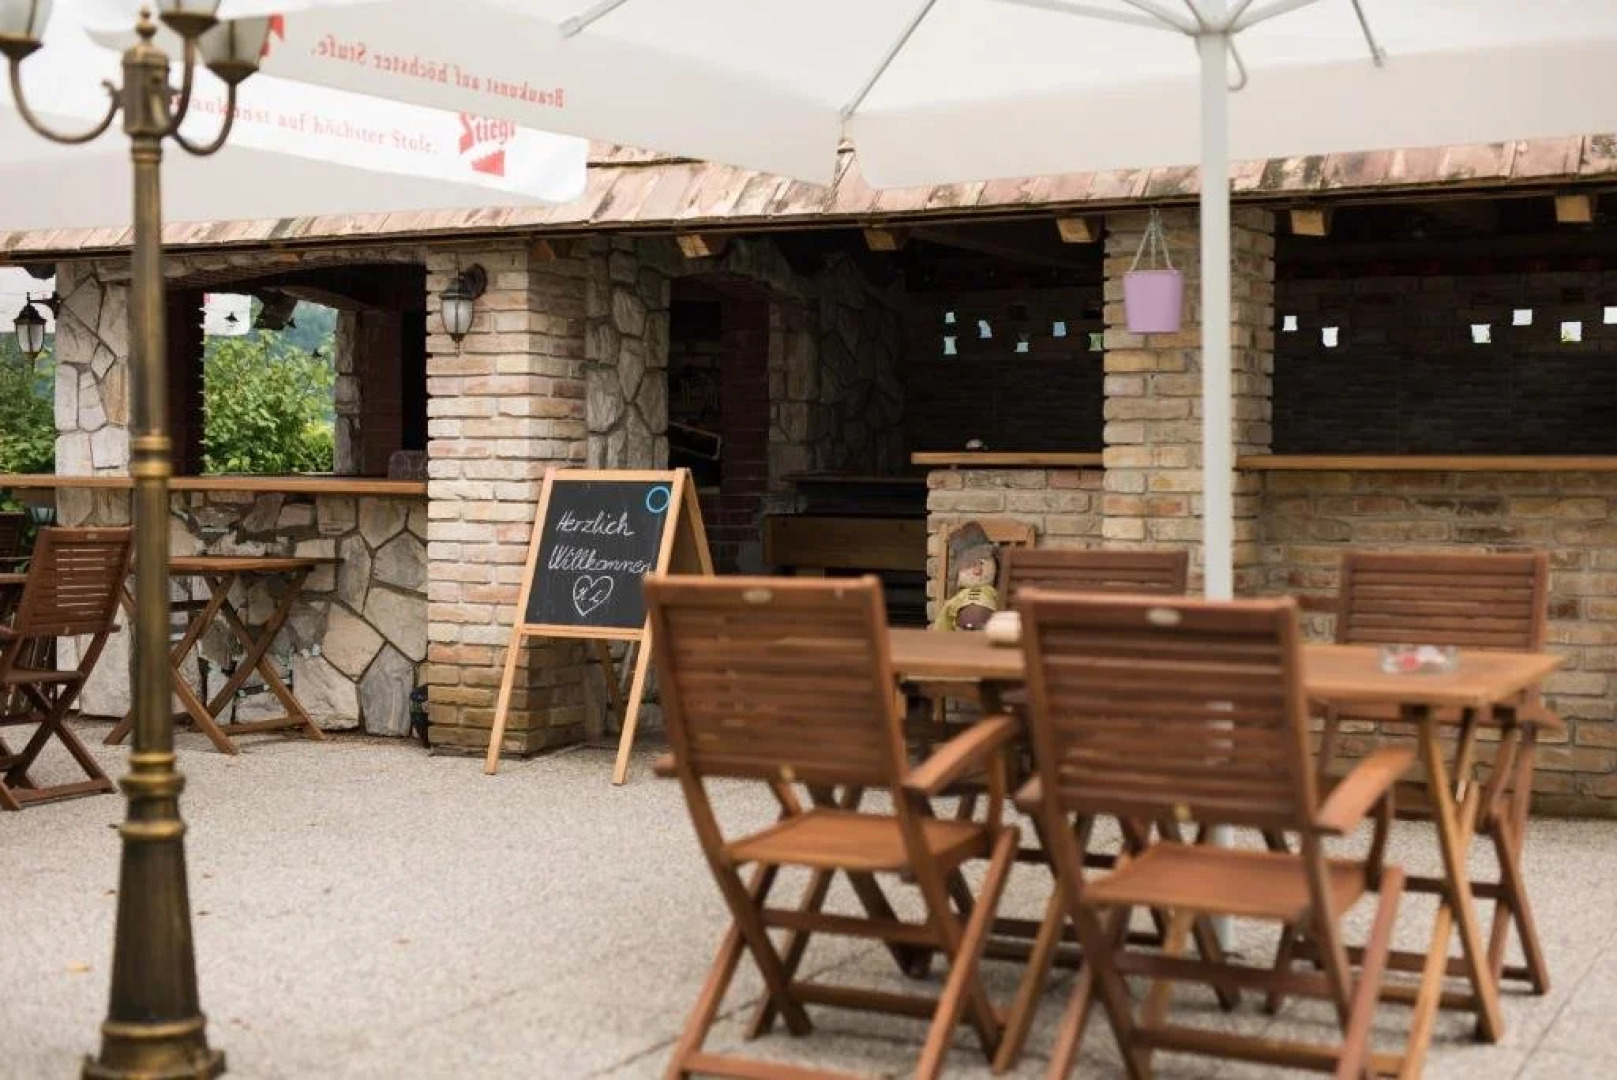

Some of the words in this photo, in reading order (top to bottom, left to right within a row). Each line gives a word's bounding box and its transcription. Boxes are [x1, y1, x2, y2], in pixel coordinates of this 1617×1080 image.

[277, 111, 306, 132] auf
[555, 509, 636, 536] Herzlich
[548, 544, 651, 575] Willkommen
